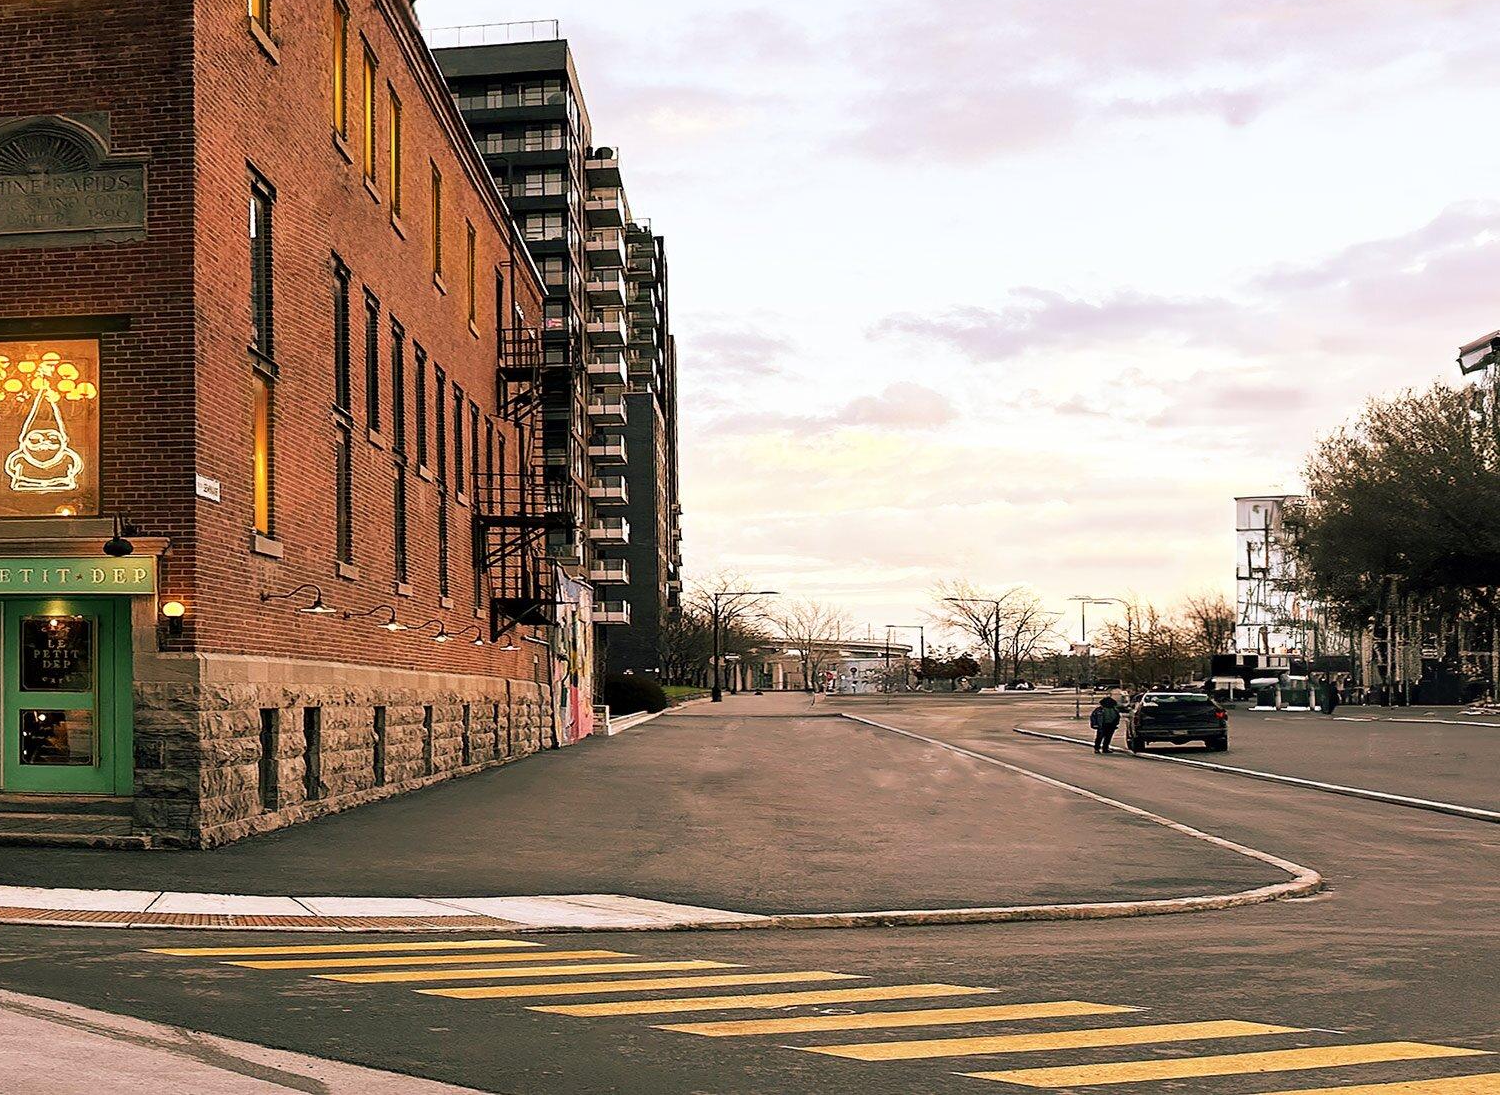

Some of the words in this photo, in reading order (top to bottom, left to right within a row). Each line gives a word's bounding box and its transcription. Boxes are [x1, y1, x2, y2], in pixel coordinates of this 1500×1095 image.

[52, 174, 130, 193] RAPIDS
[91, 568, 149, 584] DEP
[47, 639, 66, 649] LE
[33, 649, 80, 659] PETIT
[42, 660, 71, 669] DEP
